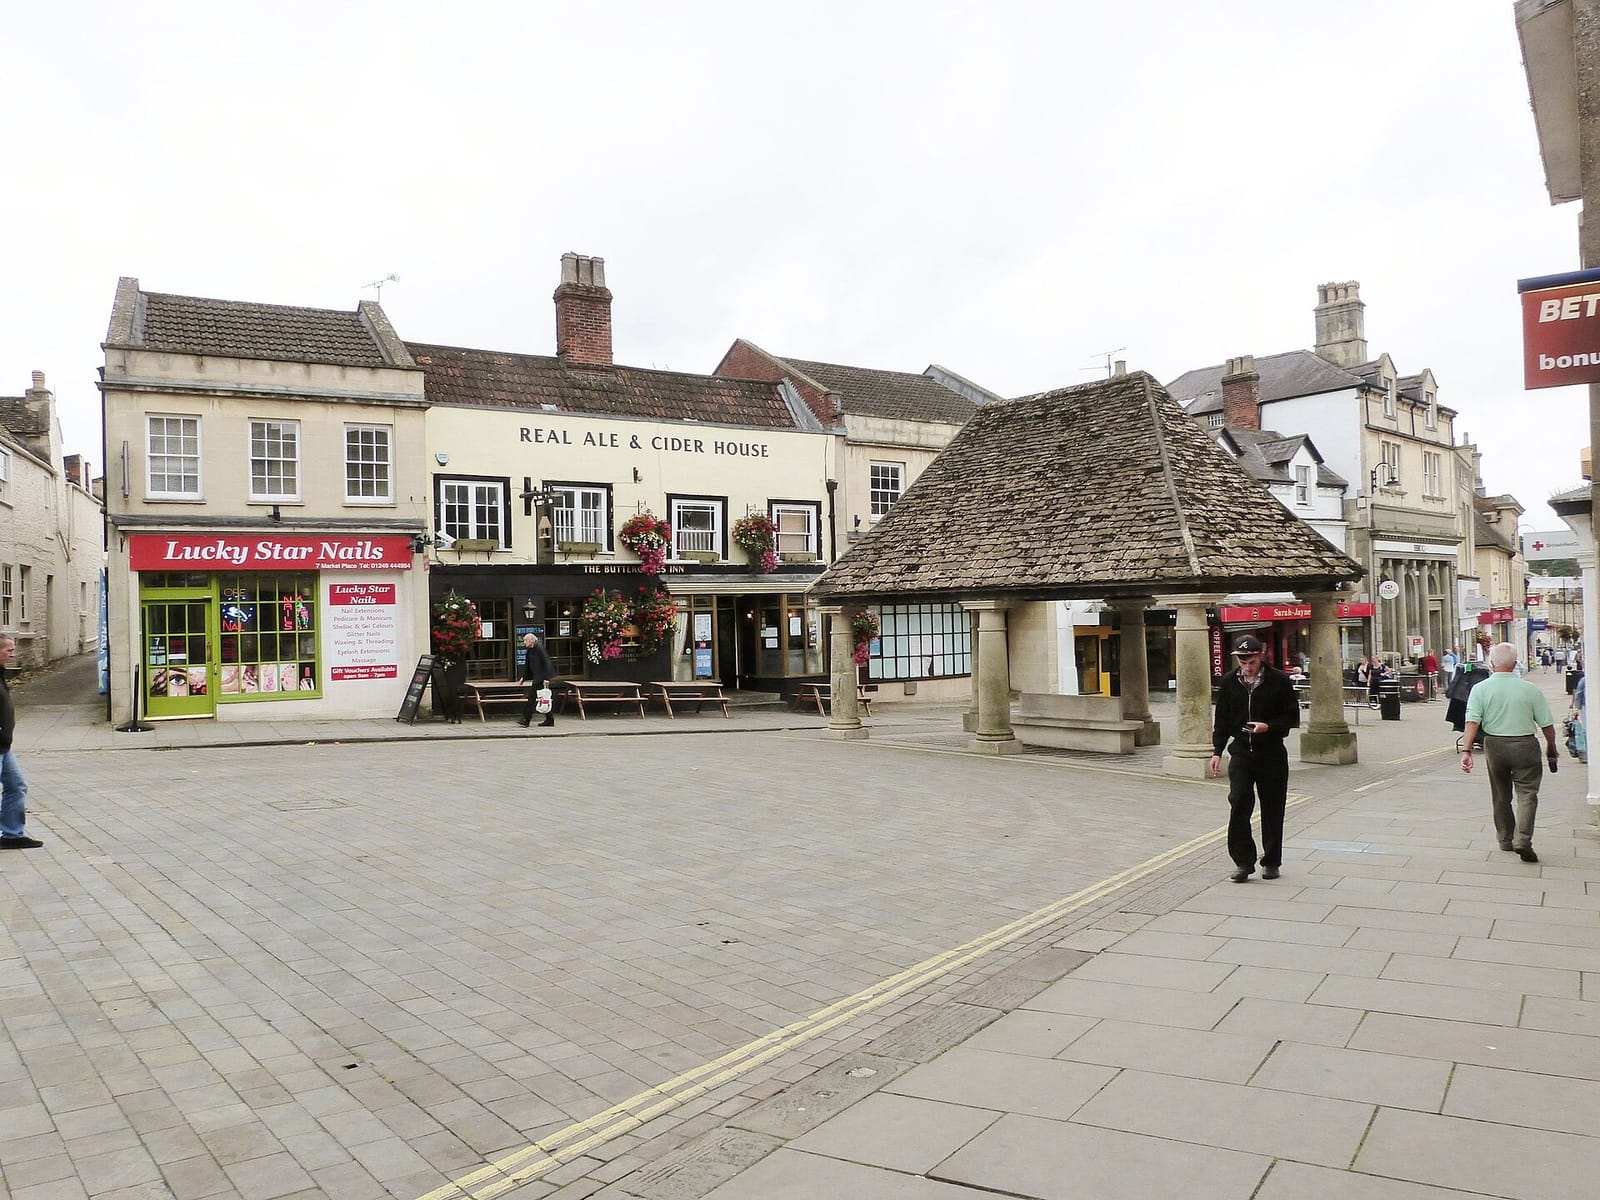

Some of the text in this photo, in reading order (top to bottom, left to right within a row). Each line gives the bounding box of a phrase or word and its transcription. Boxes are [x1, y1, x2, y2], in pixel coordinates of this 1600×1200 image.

[1538, 293, 1600, 323] BET
[519, 427, 769, 458] REAL ALE & CIDER HOUSE
[163, 539, 384, 565] Lucky Star Nails
[583, 565, 685, 574] THE BUTTERCSS INN
[336, 586, 366, 594] Lucky
[350, 596, 376, 604] Nails
[1214, 654, 1221, 665] TO
